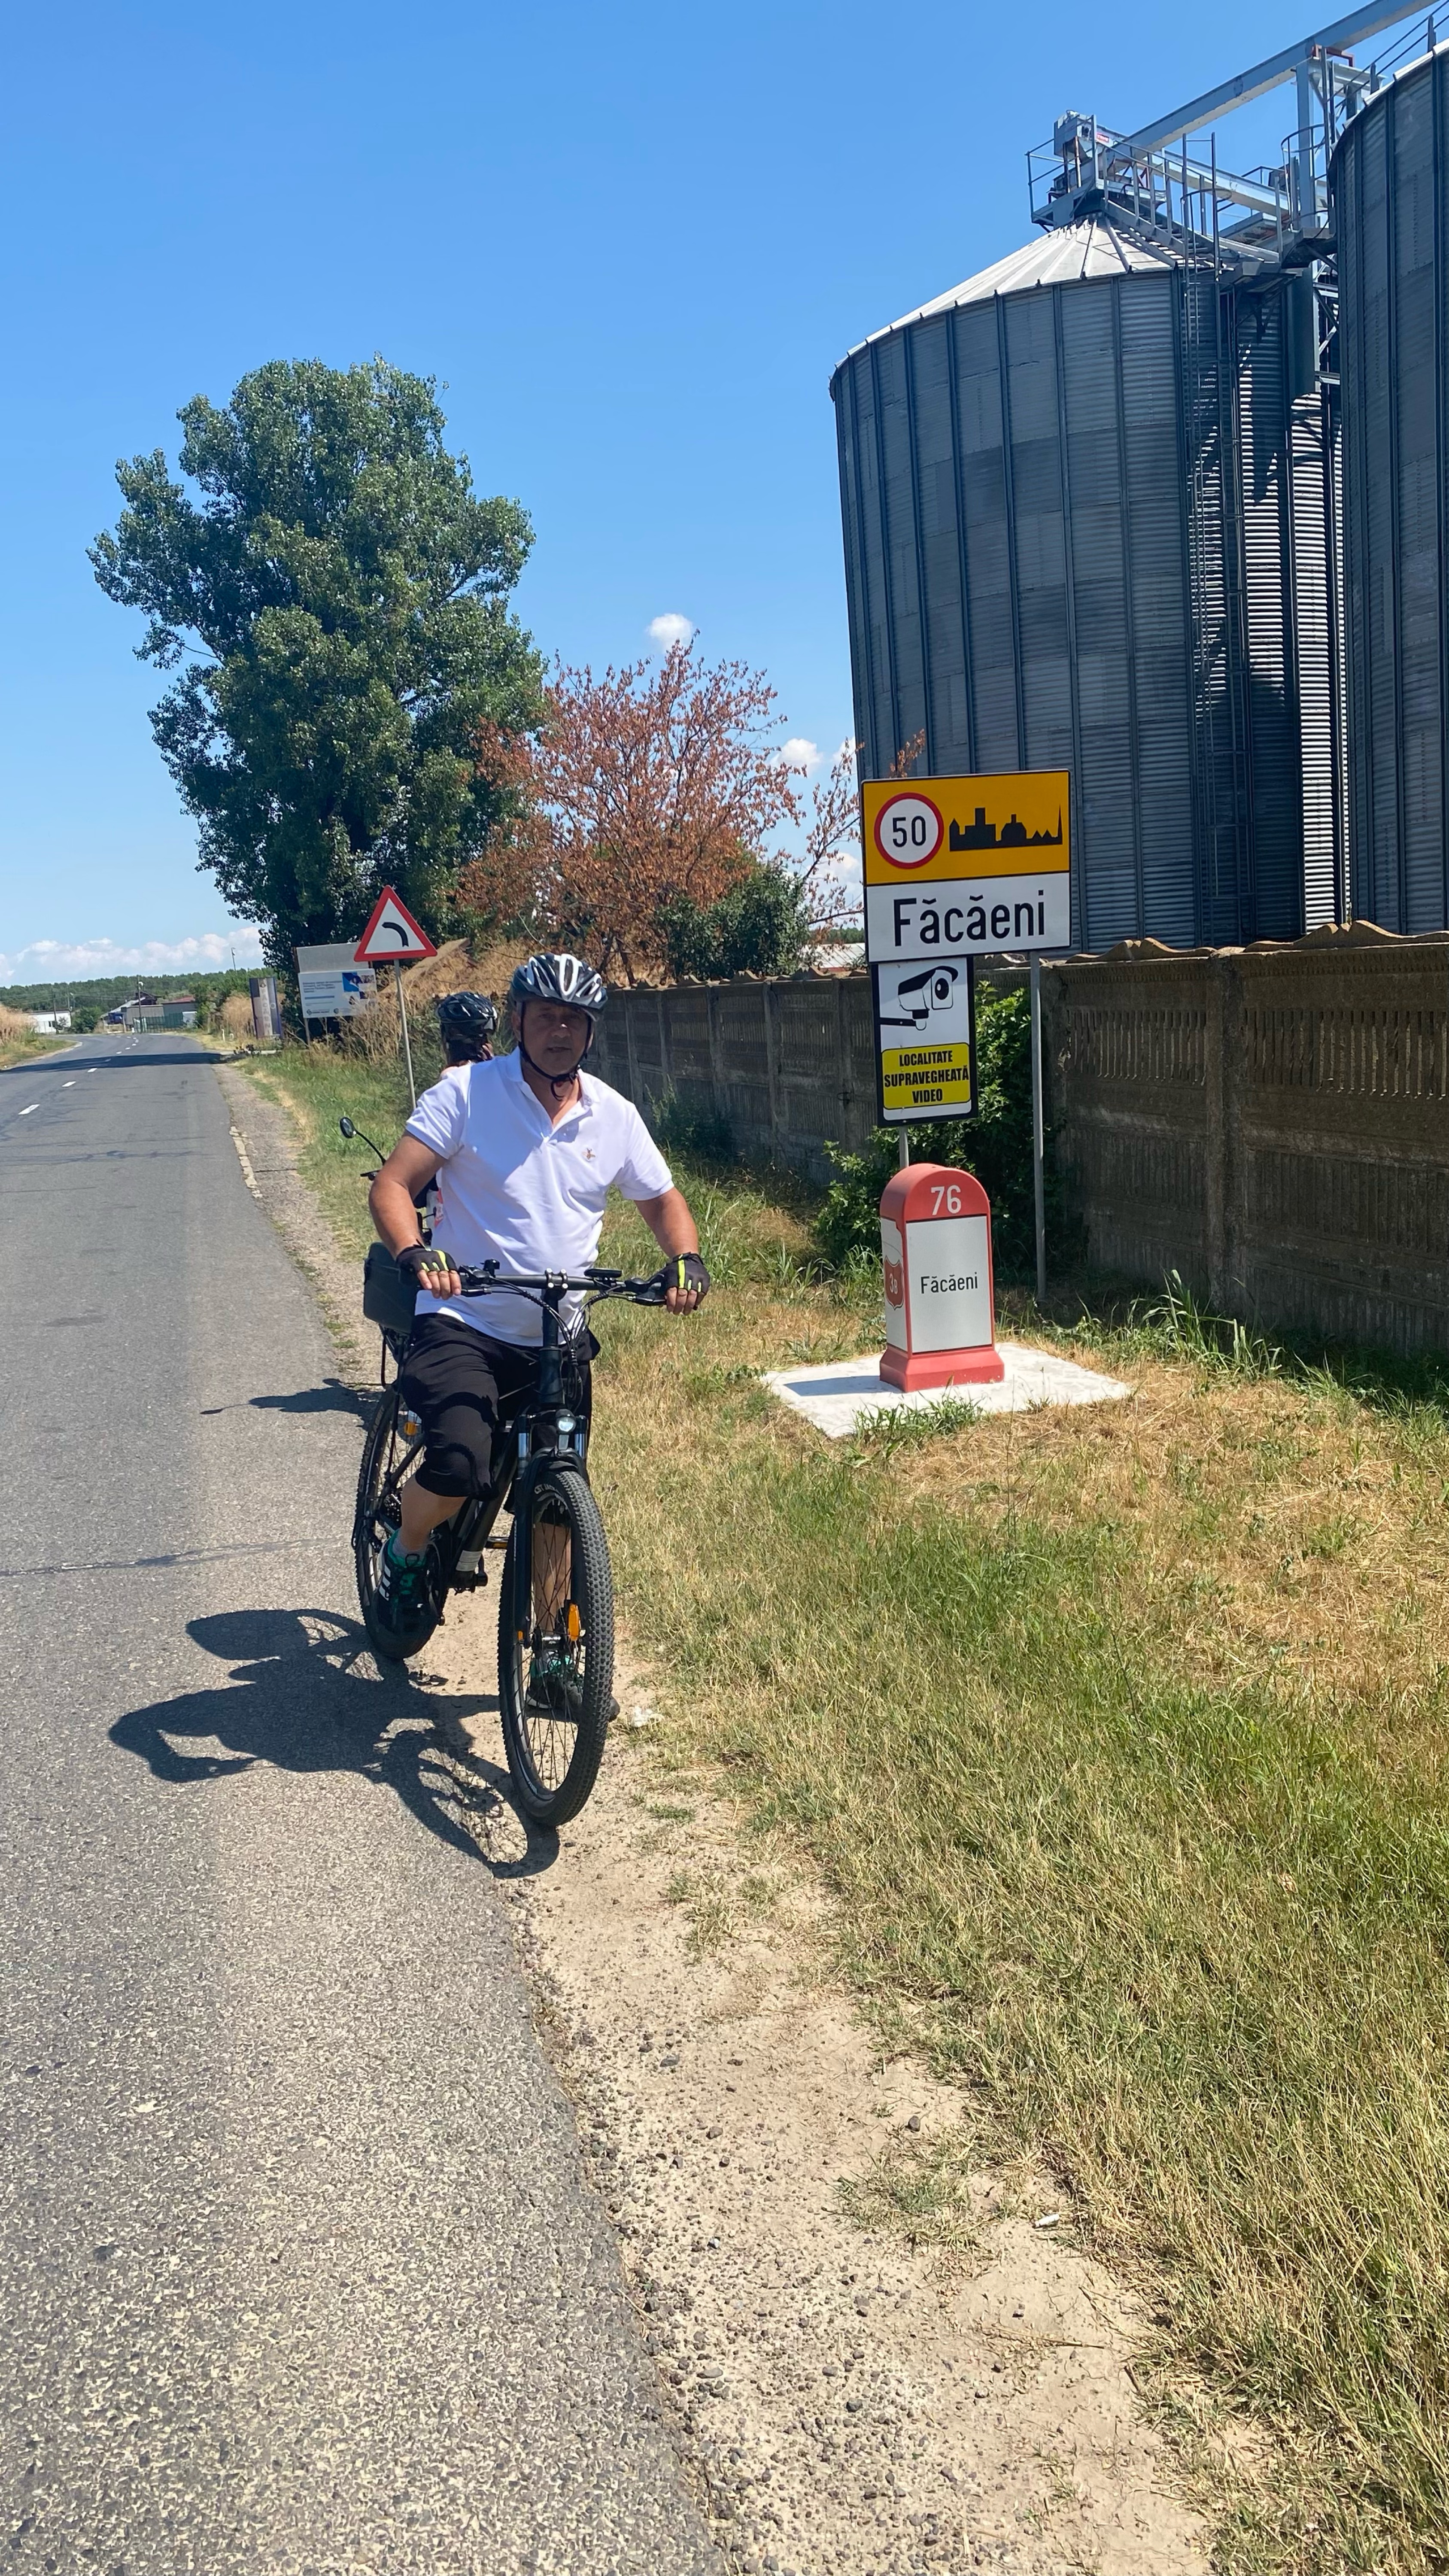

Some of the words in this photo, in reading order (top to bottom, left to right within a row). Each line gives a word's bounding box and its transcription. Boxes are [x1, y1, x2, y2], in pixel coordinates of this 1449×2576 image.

[892, 816, 926, 848] 50
[893, 890, 1045, 947] Făcăeni
[899, 1050, 953, 1067] LOCALITATE
[884, 1065, 969, 1088] SUPRAVEGHEATĂ
[912, 1088, 943, 1104] VIDEO
[931, 1185, 961, 1215] 76
[889, 1273, 898, 1294] 3B
[920, 1272, 978, 1294] Făcăeni
